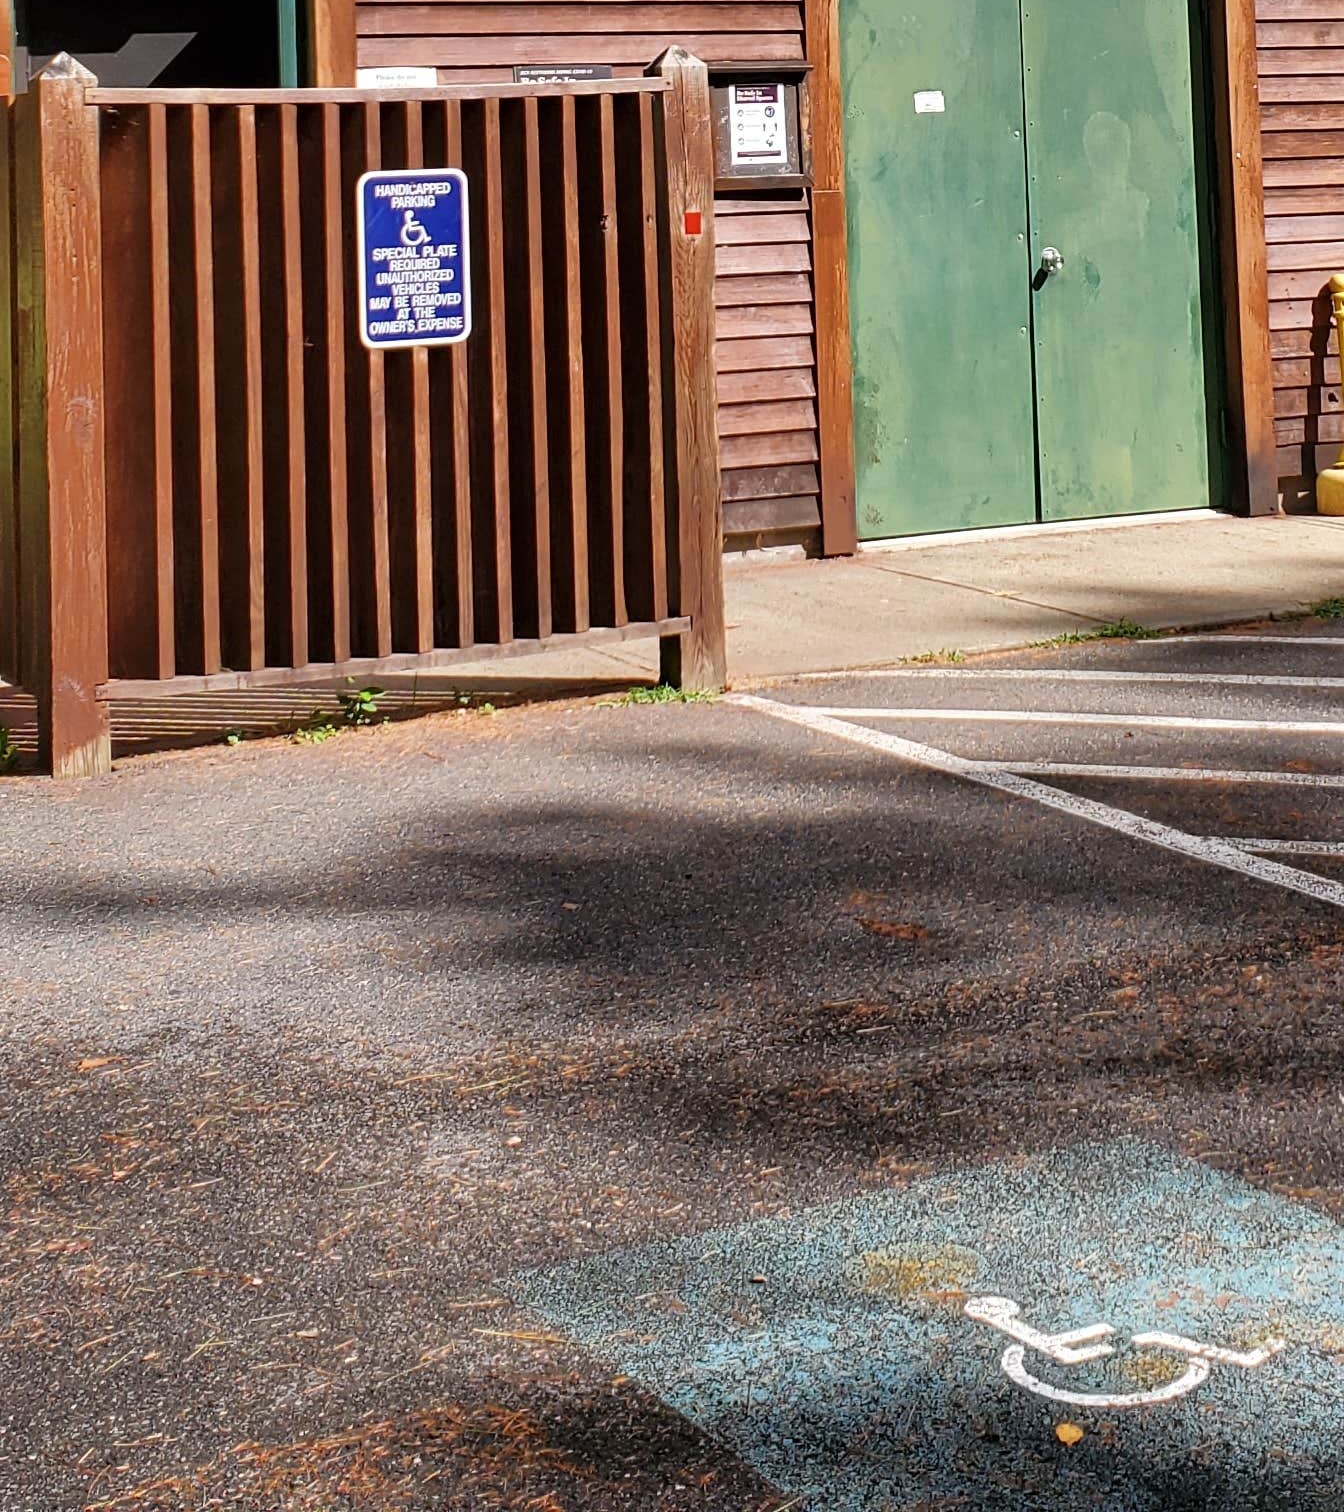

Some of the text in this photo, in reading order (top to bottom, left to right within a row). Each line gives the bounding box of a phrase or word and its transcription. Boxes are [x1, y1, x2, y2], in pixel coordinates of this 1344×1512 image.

[375, 182, 452, 197] HANDICAPPED
[391, 195, 435, 209] PARKING
[372, 245, 458, 261] SPECIAL PLATE
[389, 258, 441, 272] REQUIRED
[376, 269, 454, 285] UNAUTHORIZED
[391, 282, 440, 296] VEHICLES
[369, 293, 462, 310] MAY BE REMOVED
[397, 307, 436, 320] AT THE
[369, 317, 464, 335] OWNER'S EXPENSE
